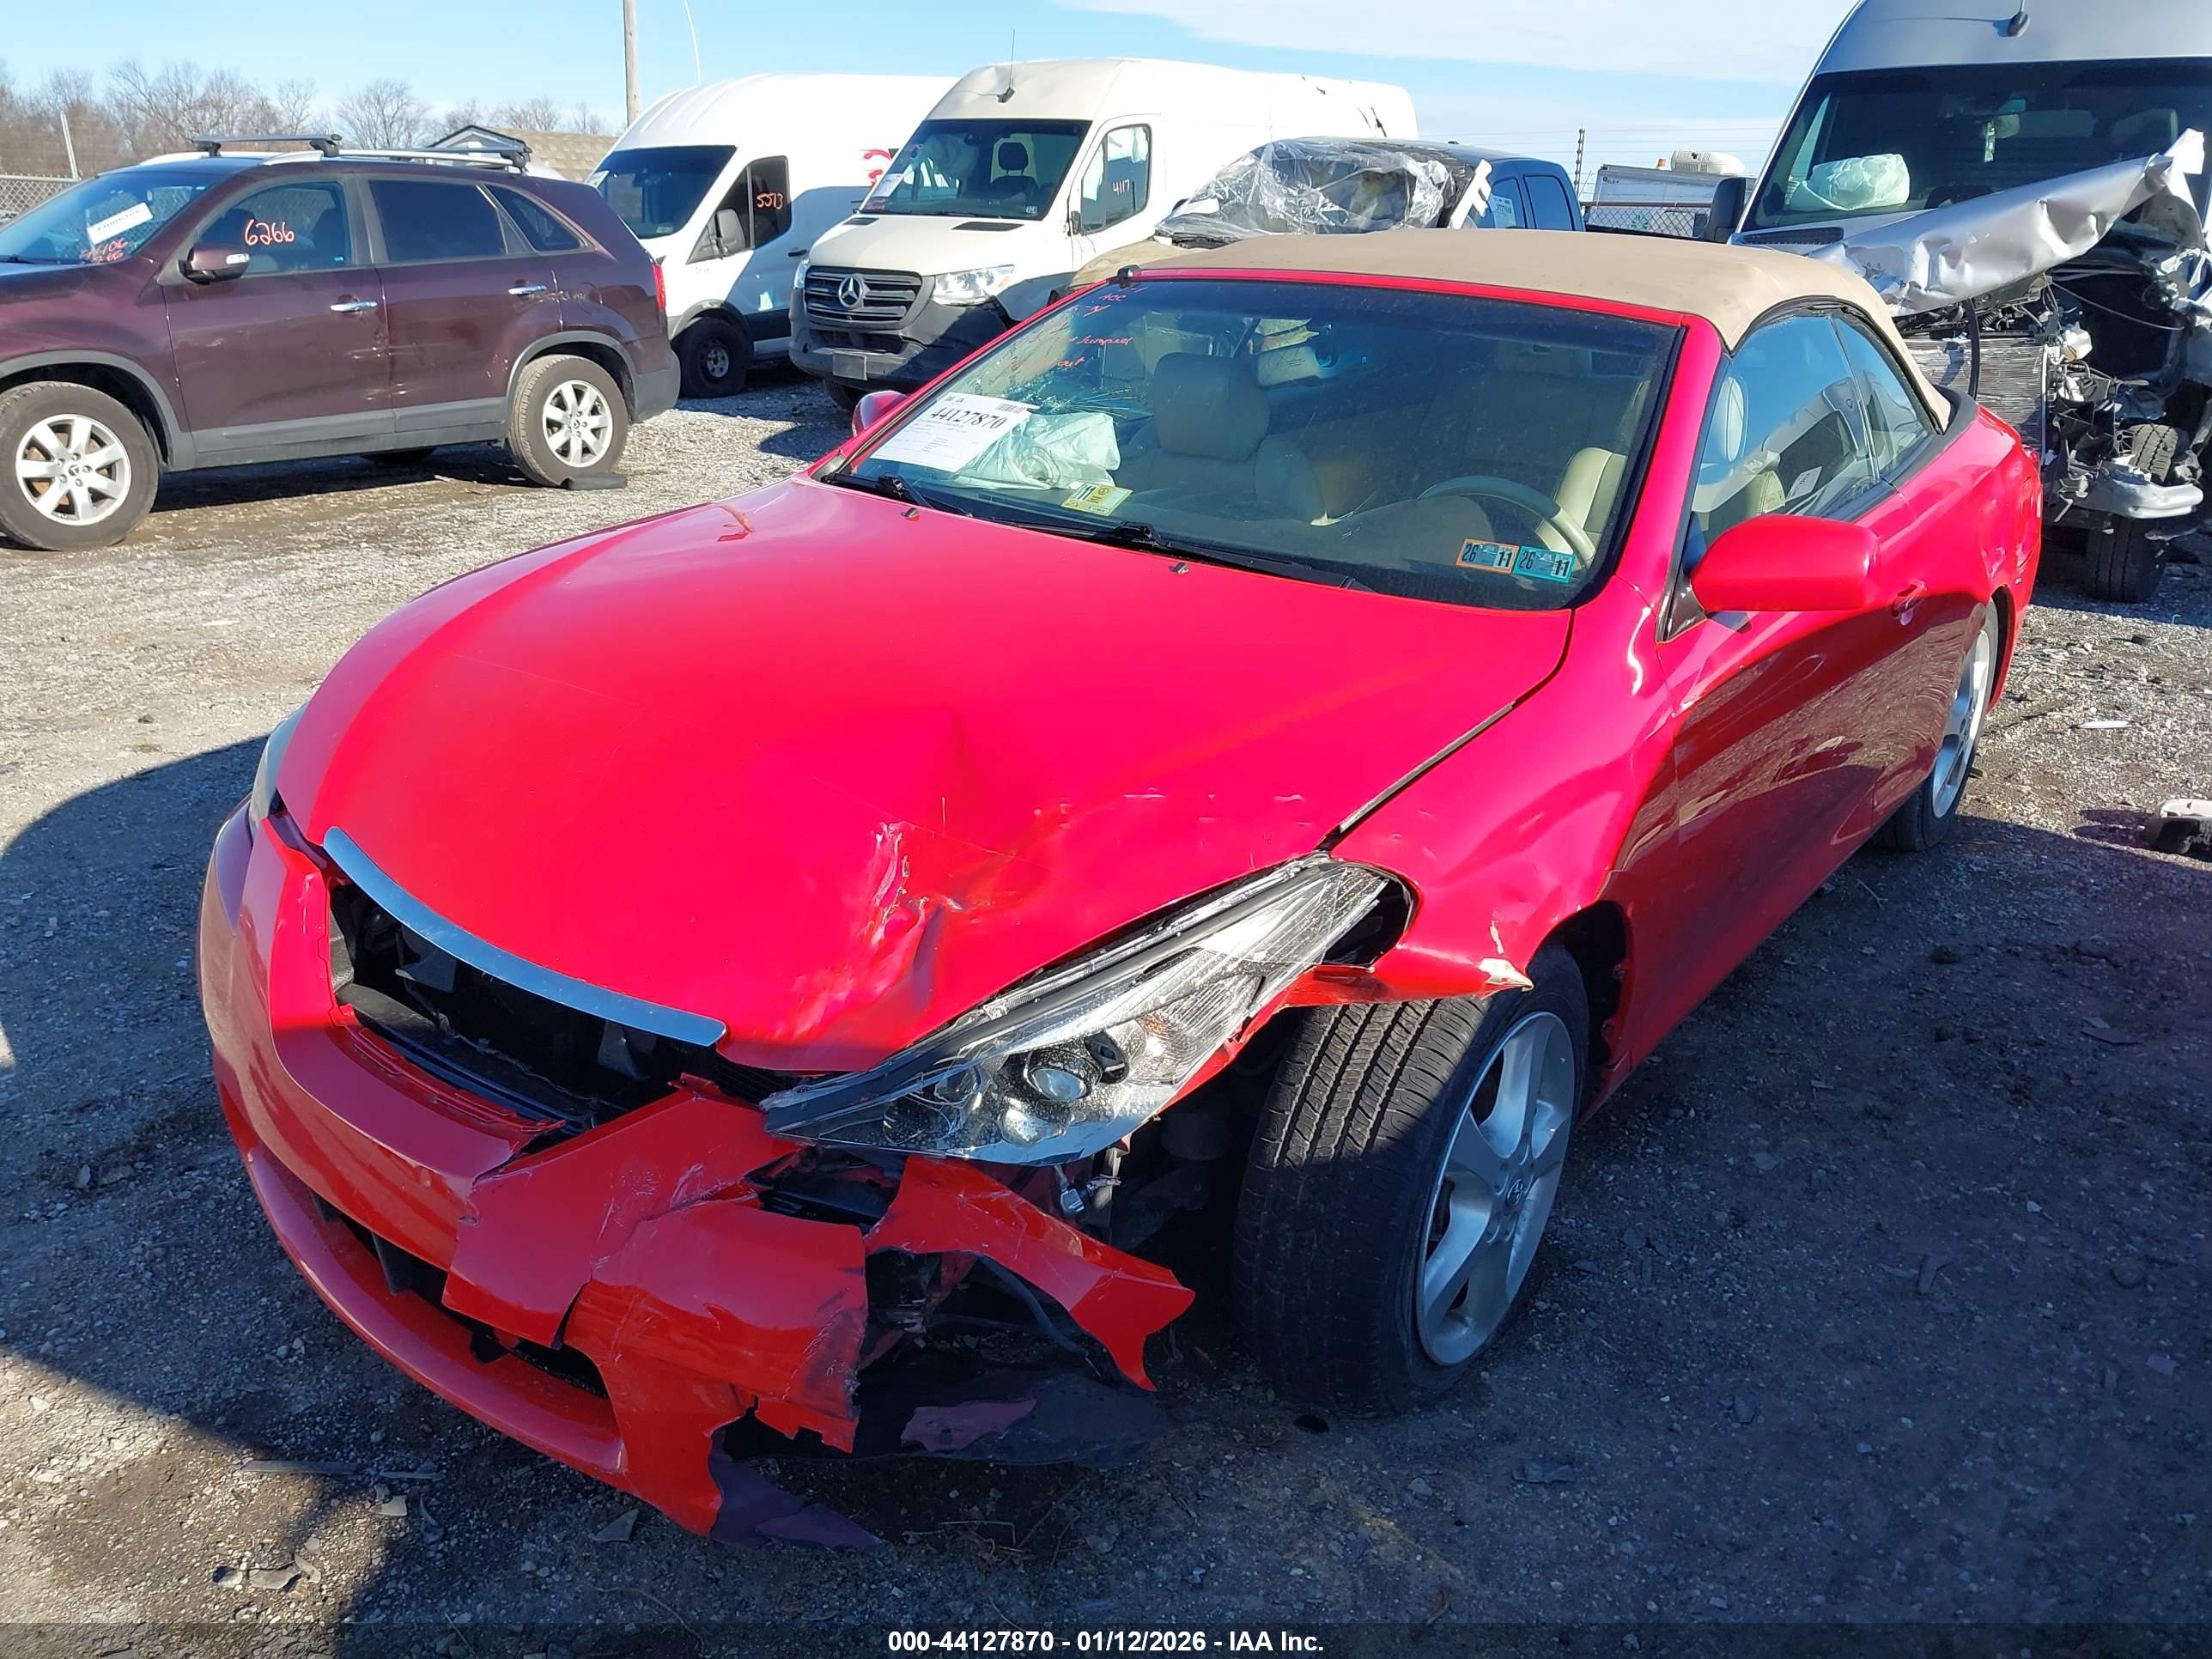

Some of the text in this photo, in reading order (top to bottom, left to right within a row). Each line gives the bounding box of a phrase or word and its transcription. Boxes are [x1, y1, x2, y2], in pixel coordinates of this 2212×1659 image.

[1113, 179, 1131, 193] 4117
[757, 192, 784, 210] 5513
[243, 218, 295, 246] 6266
[931, 406, 1007, 429] 44127870
[1462, 542, 1479, 563] 26
[1518, 550, 1535, 570] 26
